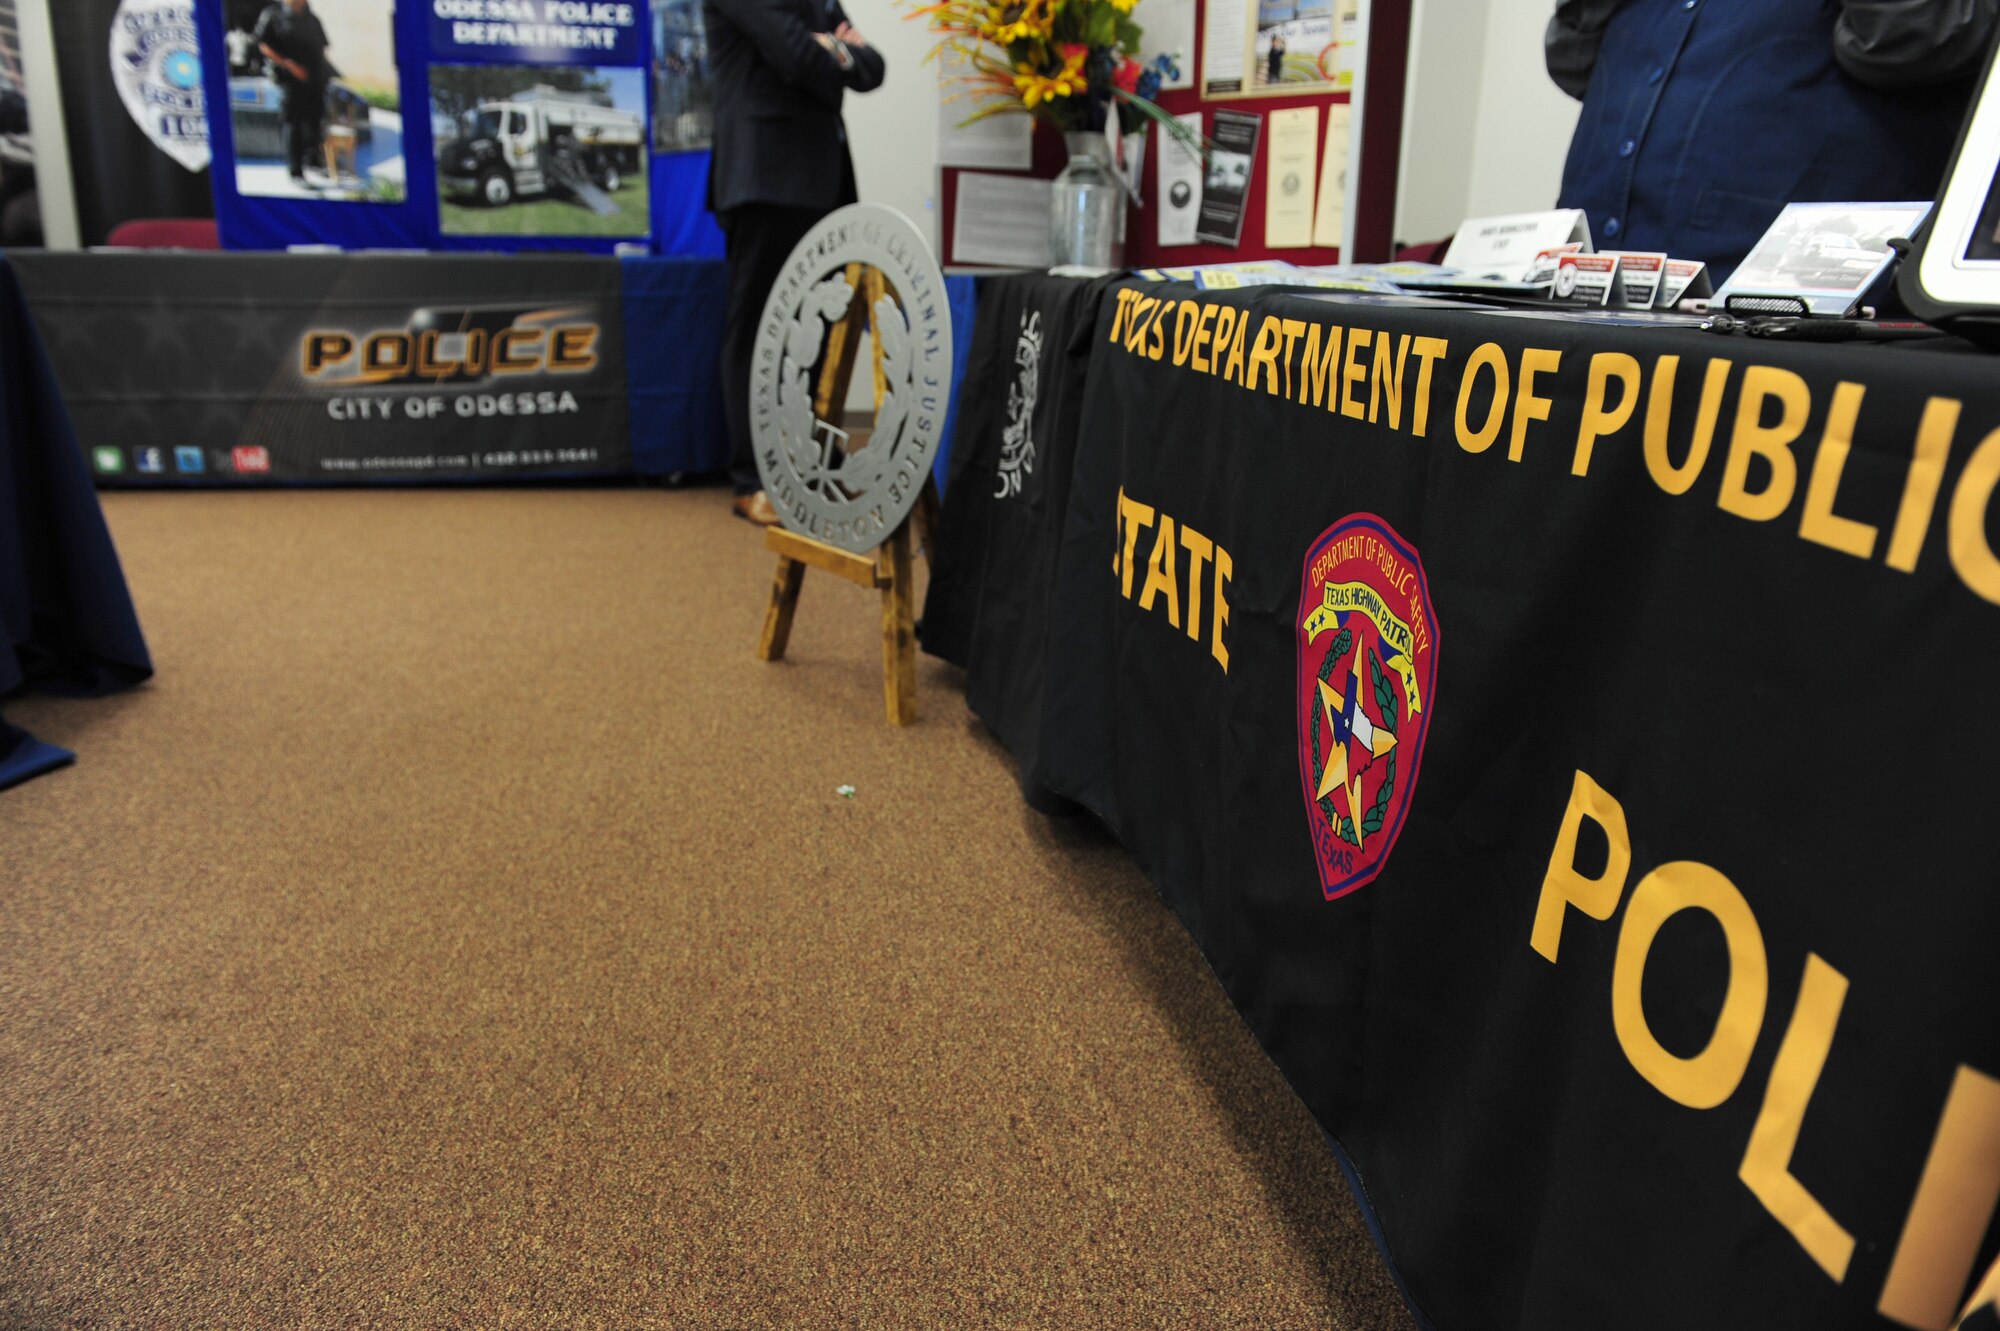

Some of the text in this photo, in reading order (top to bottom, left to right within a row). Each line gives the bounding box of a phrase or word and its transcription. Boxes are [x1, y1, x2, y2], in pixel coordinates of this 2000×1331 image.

[433, 0, 635, 27] ODESSA POLICE
[452, 21, 619, 50] DEPARTMENT
[303, 324, 600, 378] POLICE
[767, 222, 859, 339] DEPARTMENT
[888, 375, 939, 505] JUSTICE
[327, 391, 579, 420] CITY OF ODESSA
[1172, 299, 1448, 438] DEPARTMENT
[1454, 341, 1563, 464] OF
[762, 448, 885, 542] MIDDLETON
[1311, 535, 1365, 588] DEPARTMENT
[1365, 537, 1378, 562] OF
[1376, 543, 1414, 596] PUBLIC
[1326, 587, 1412, 658] TEXAS HIGHWAY PATROL
[1314, 816, 1353, 875] TEXAS
